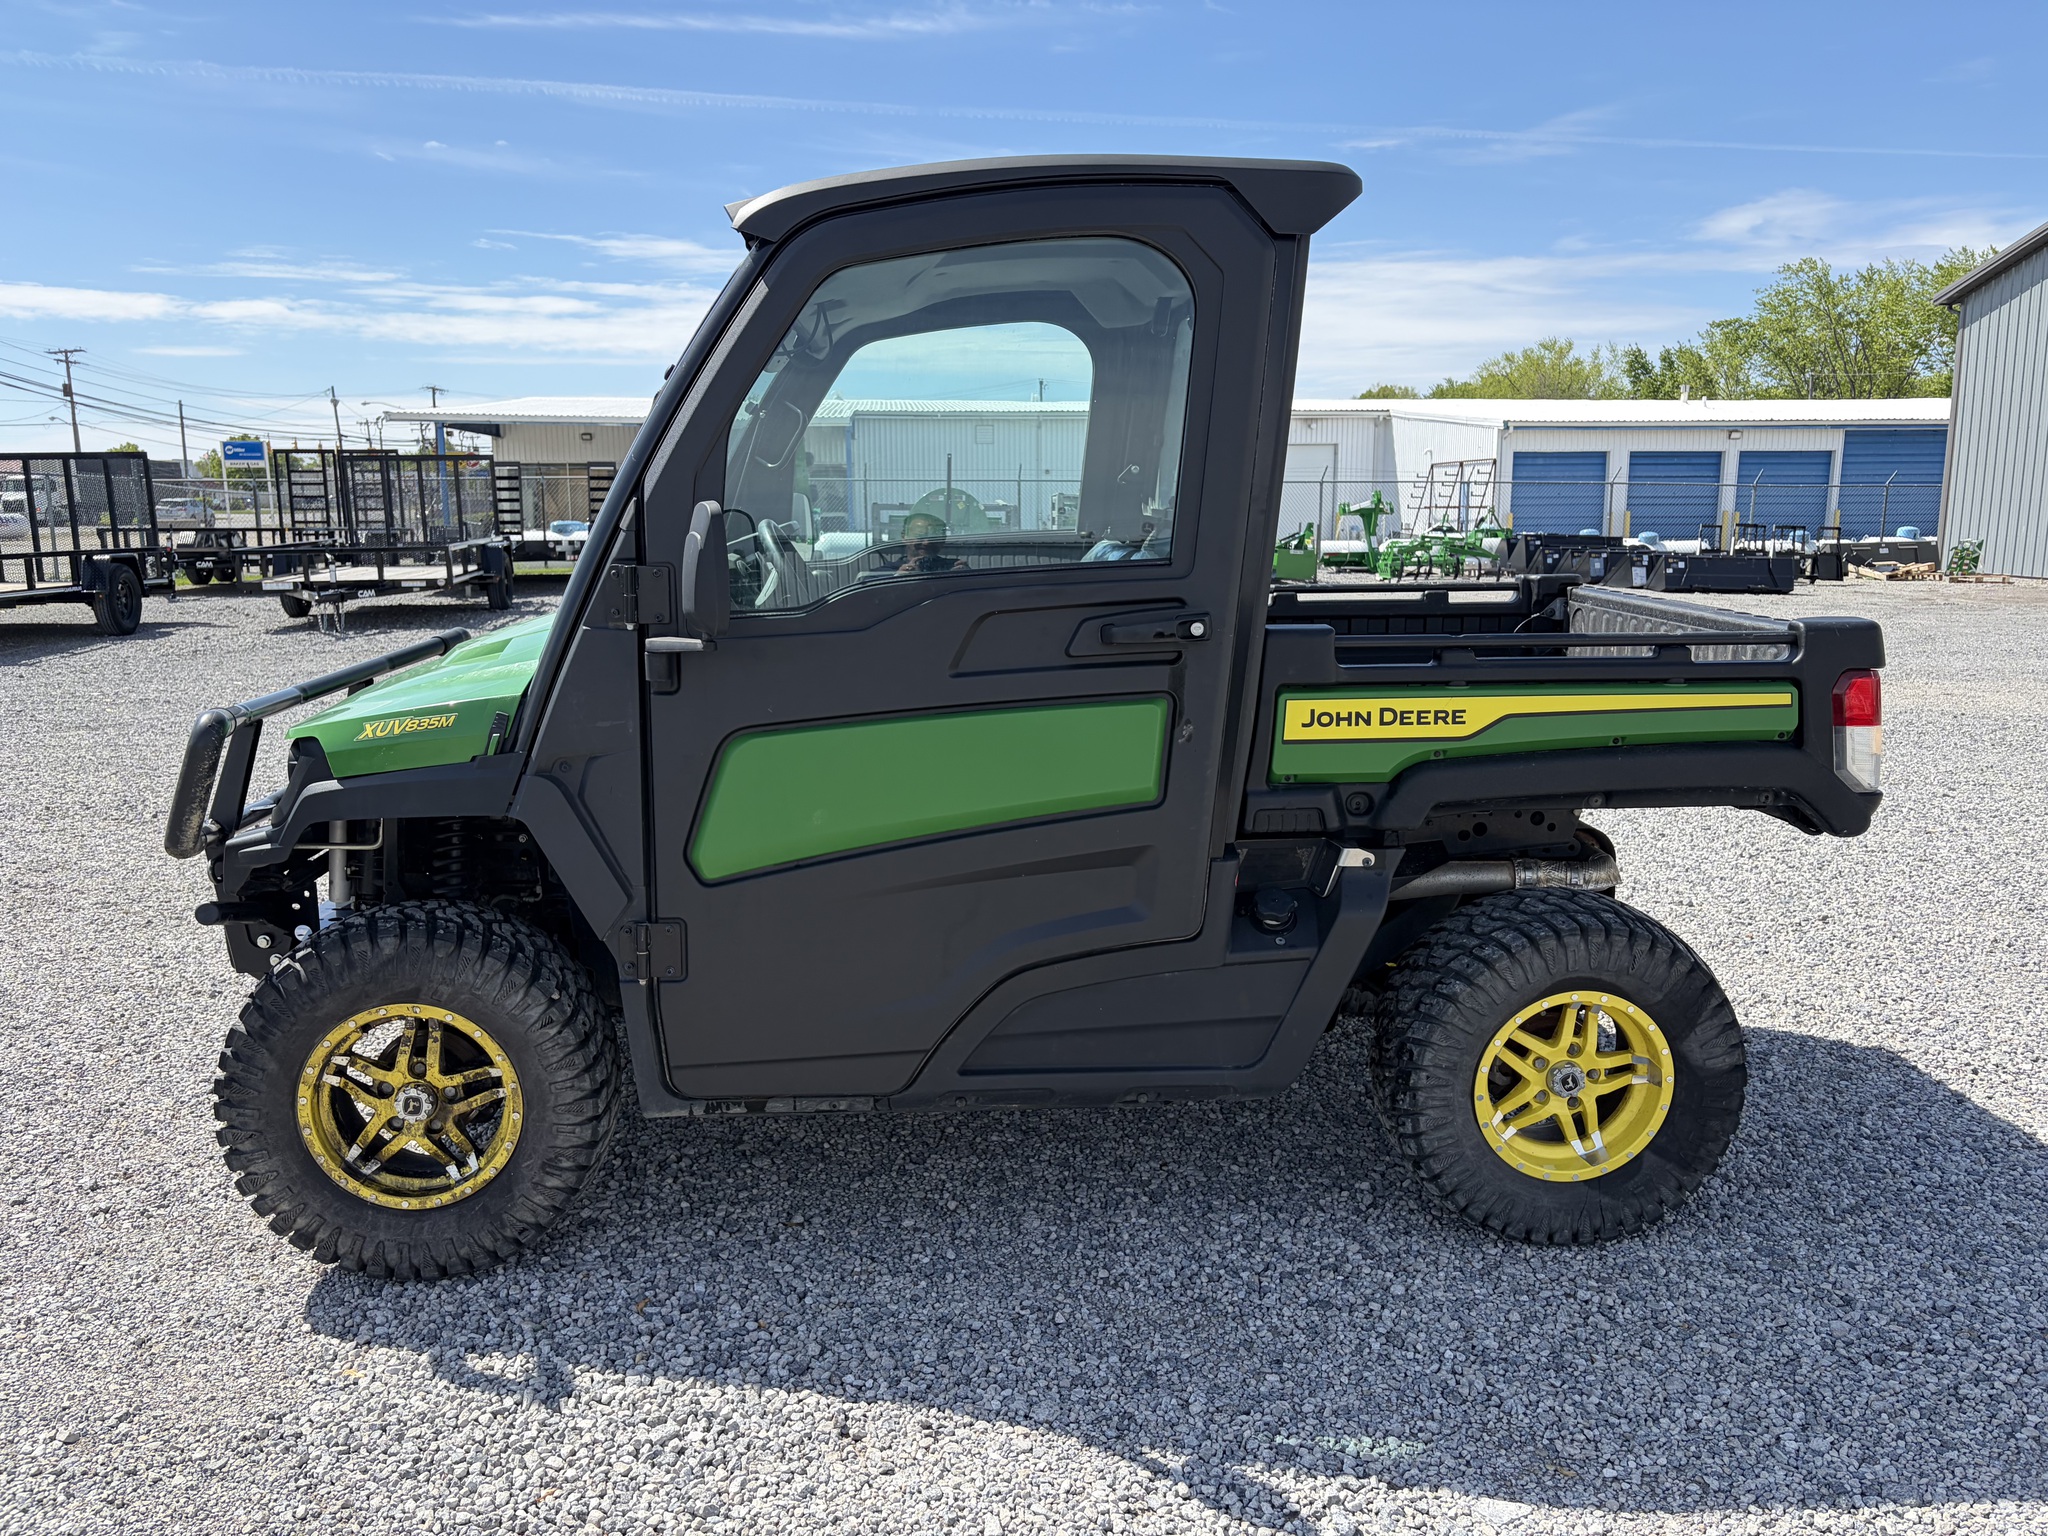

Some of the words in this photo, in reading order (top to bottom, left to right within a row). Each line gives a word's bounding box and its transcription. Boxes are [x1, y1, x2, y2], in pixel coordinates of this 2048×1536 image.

[195, 561, 213, 569] CAM
[357, 588, 376, 598] CAM
[1301, 708, 1372, 728] JOHN
[1378, 707, 1467, 727] DEERE
[357, 715, 457, 740] XUV835M
